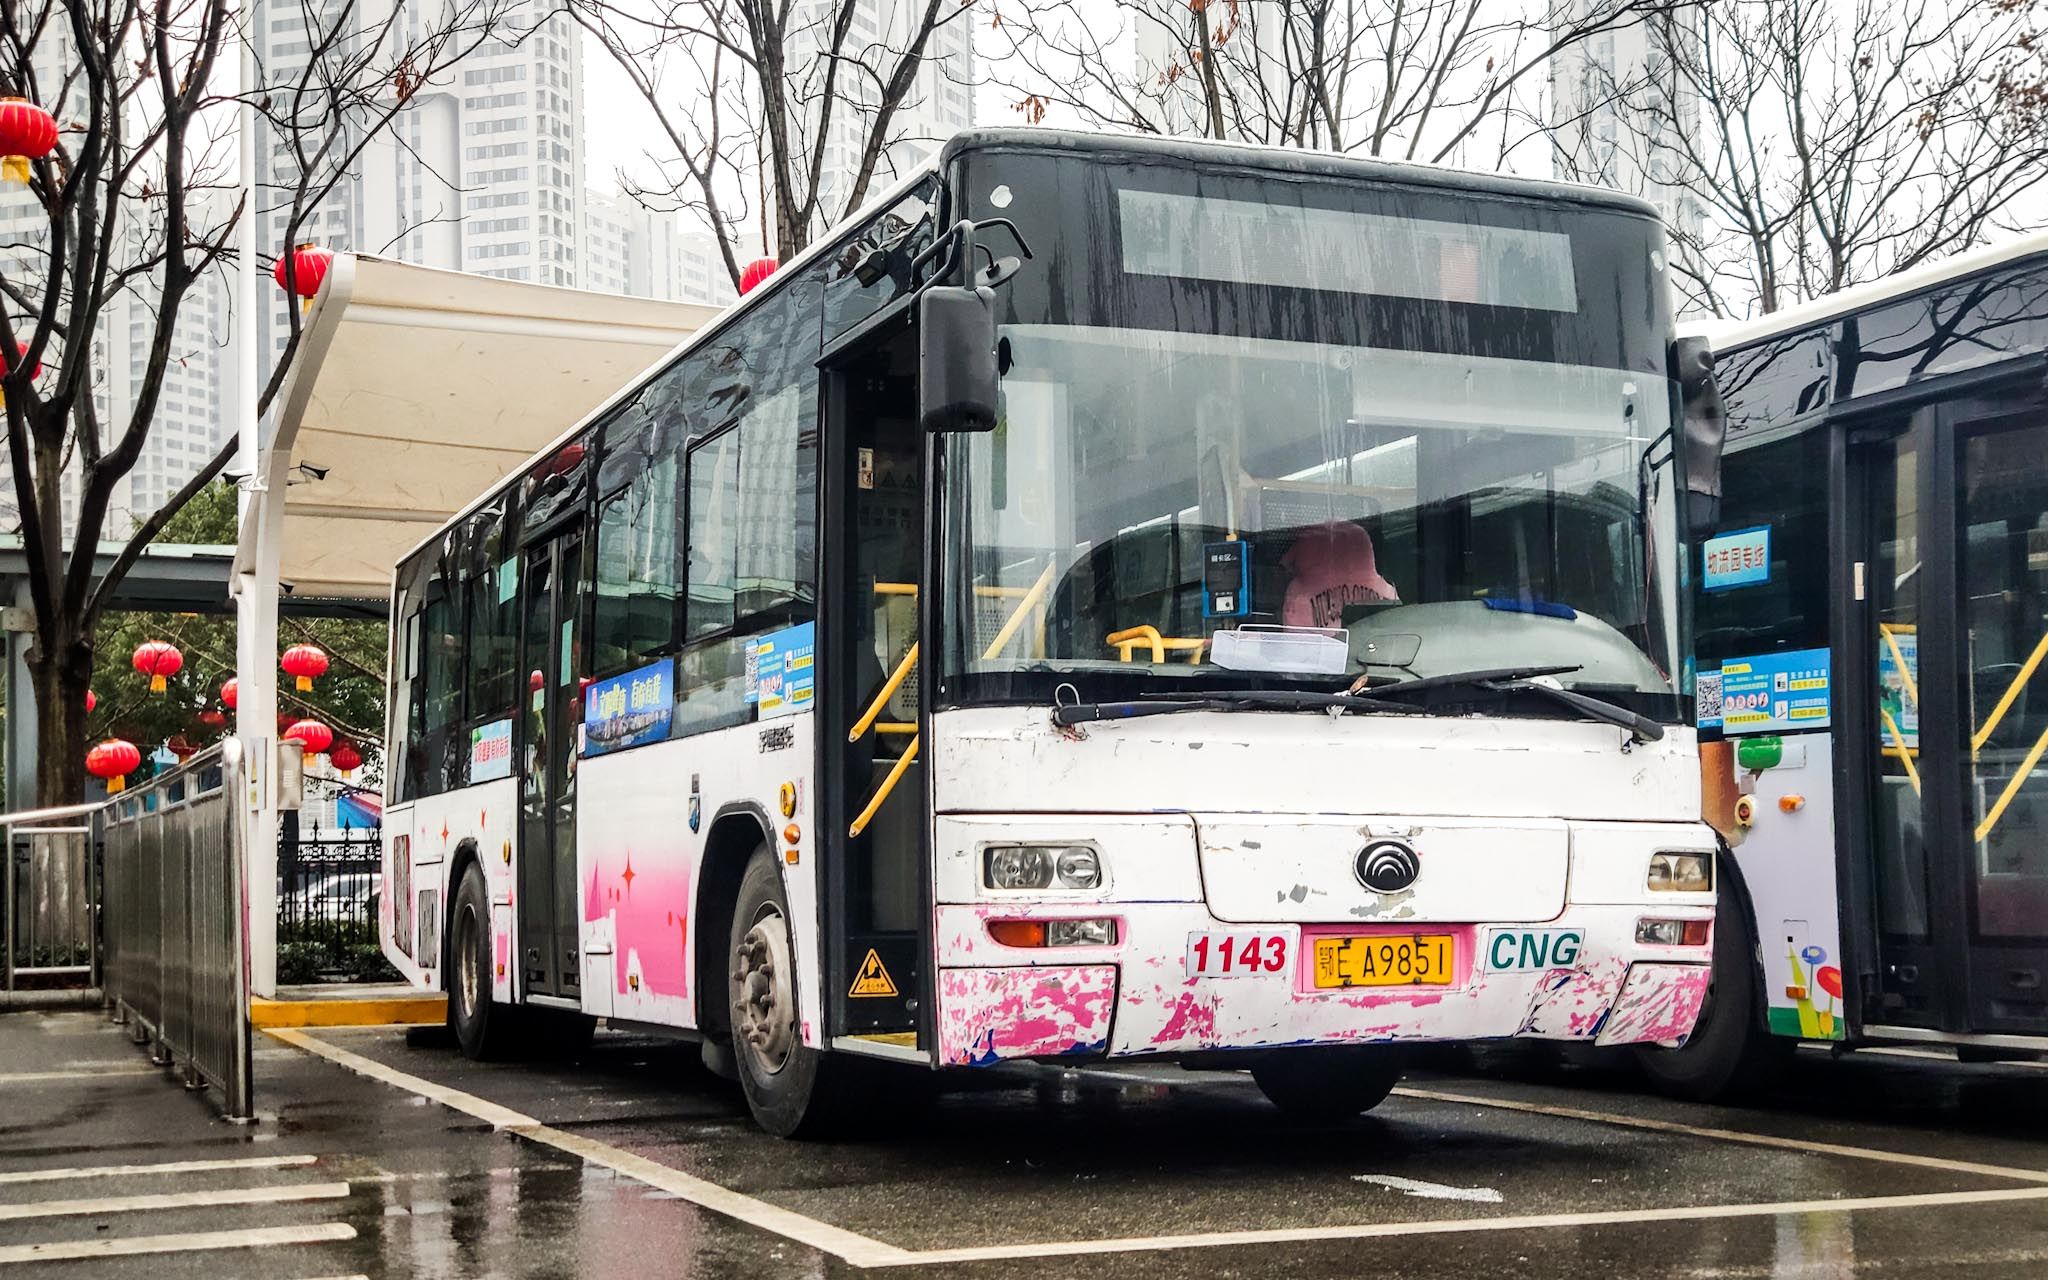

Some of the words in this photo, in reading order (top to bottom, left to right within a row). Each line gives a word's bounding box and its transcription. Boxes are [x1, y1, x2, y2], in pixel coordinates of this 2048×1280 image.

[1708, 544, 1764, 576] 物流园专线
[1194, 936, 1286, 972] 1143
[1491, 933, 1580, 969] CNG
